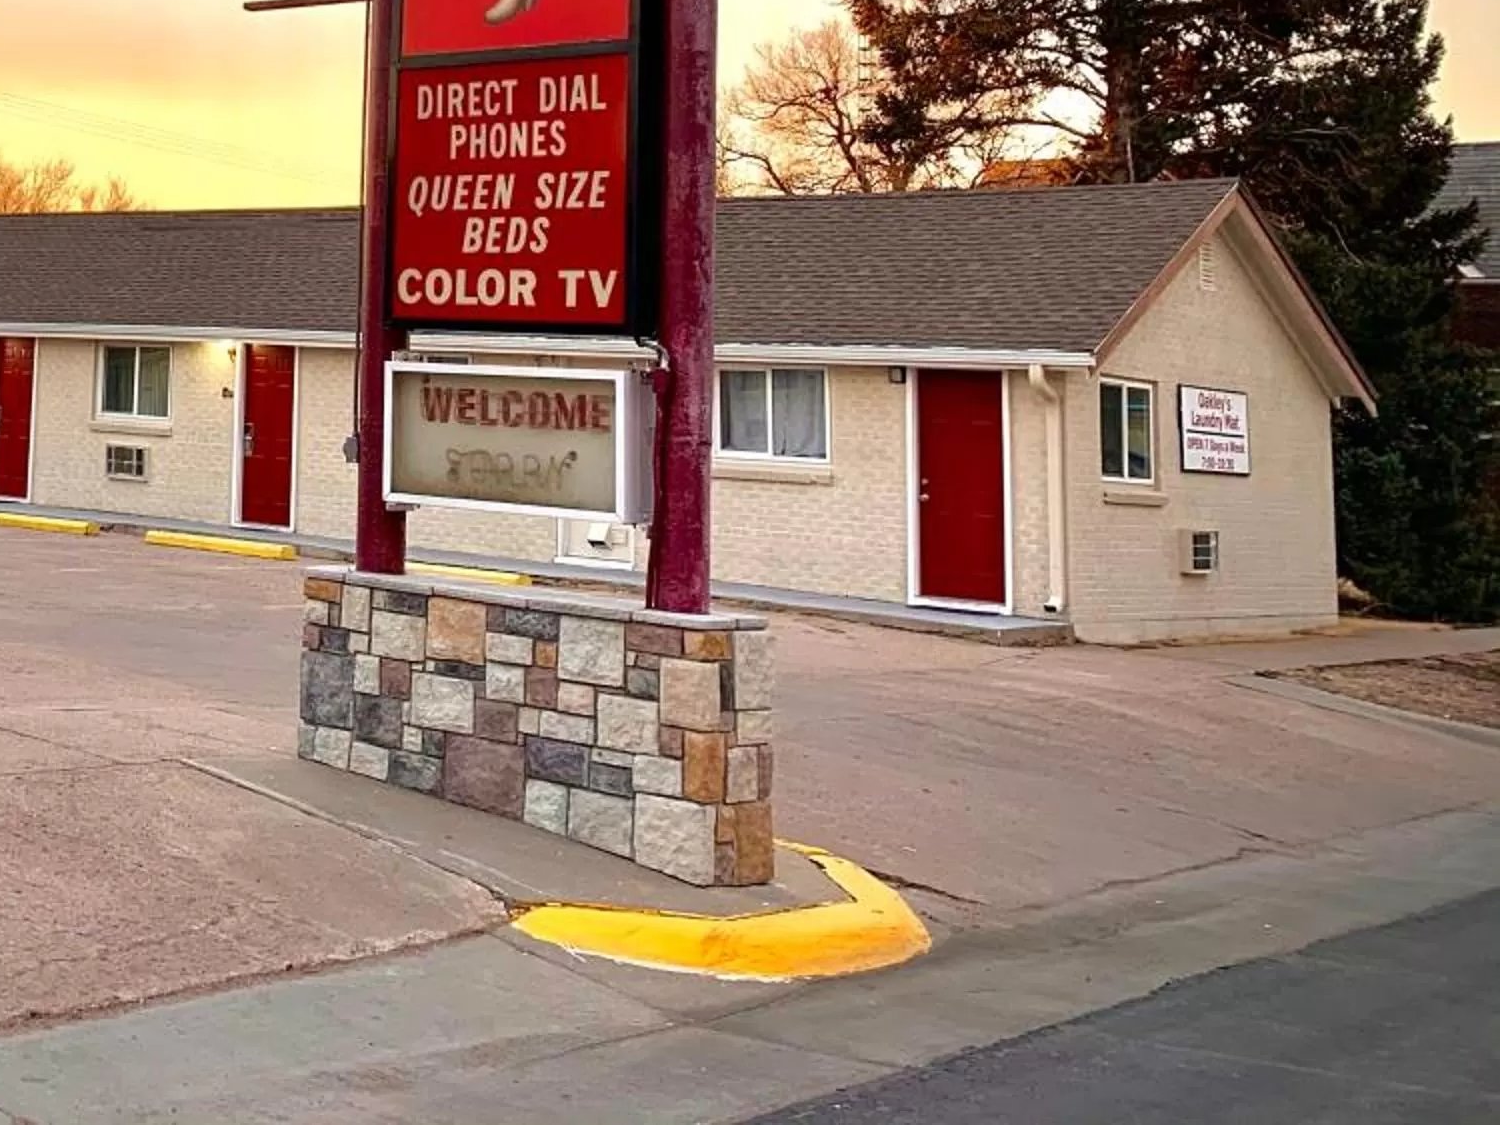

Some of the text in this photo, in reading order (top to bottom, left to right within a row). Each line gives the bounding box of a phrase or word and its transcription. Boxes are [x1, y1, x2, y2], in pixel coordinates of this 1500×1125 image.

[417, 73, 607, 120] DIRECT DIAL
[450, 120, 567, 160] PHONES
[407, 170, 610, 217] QUEEN SIZE
[461, 216, 550, 254] BEDS
[398, 268, 619, 308] COLOR TV
[422, 386, 612, 433] WELCOME
[1191, 410, 1222, 431] Laundry
[1198, 392, 1231, 413] Oakley's
